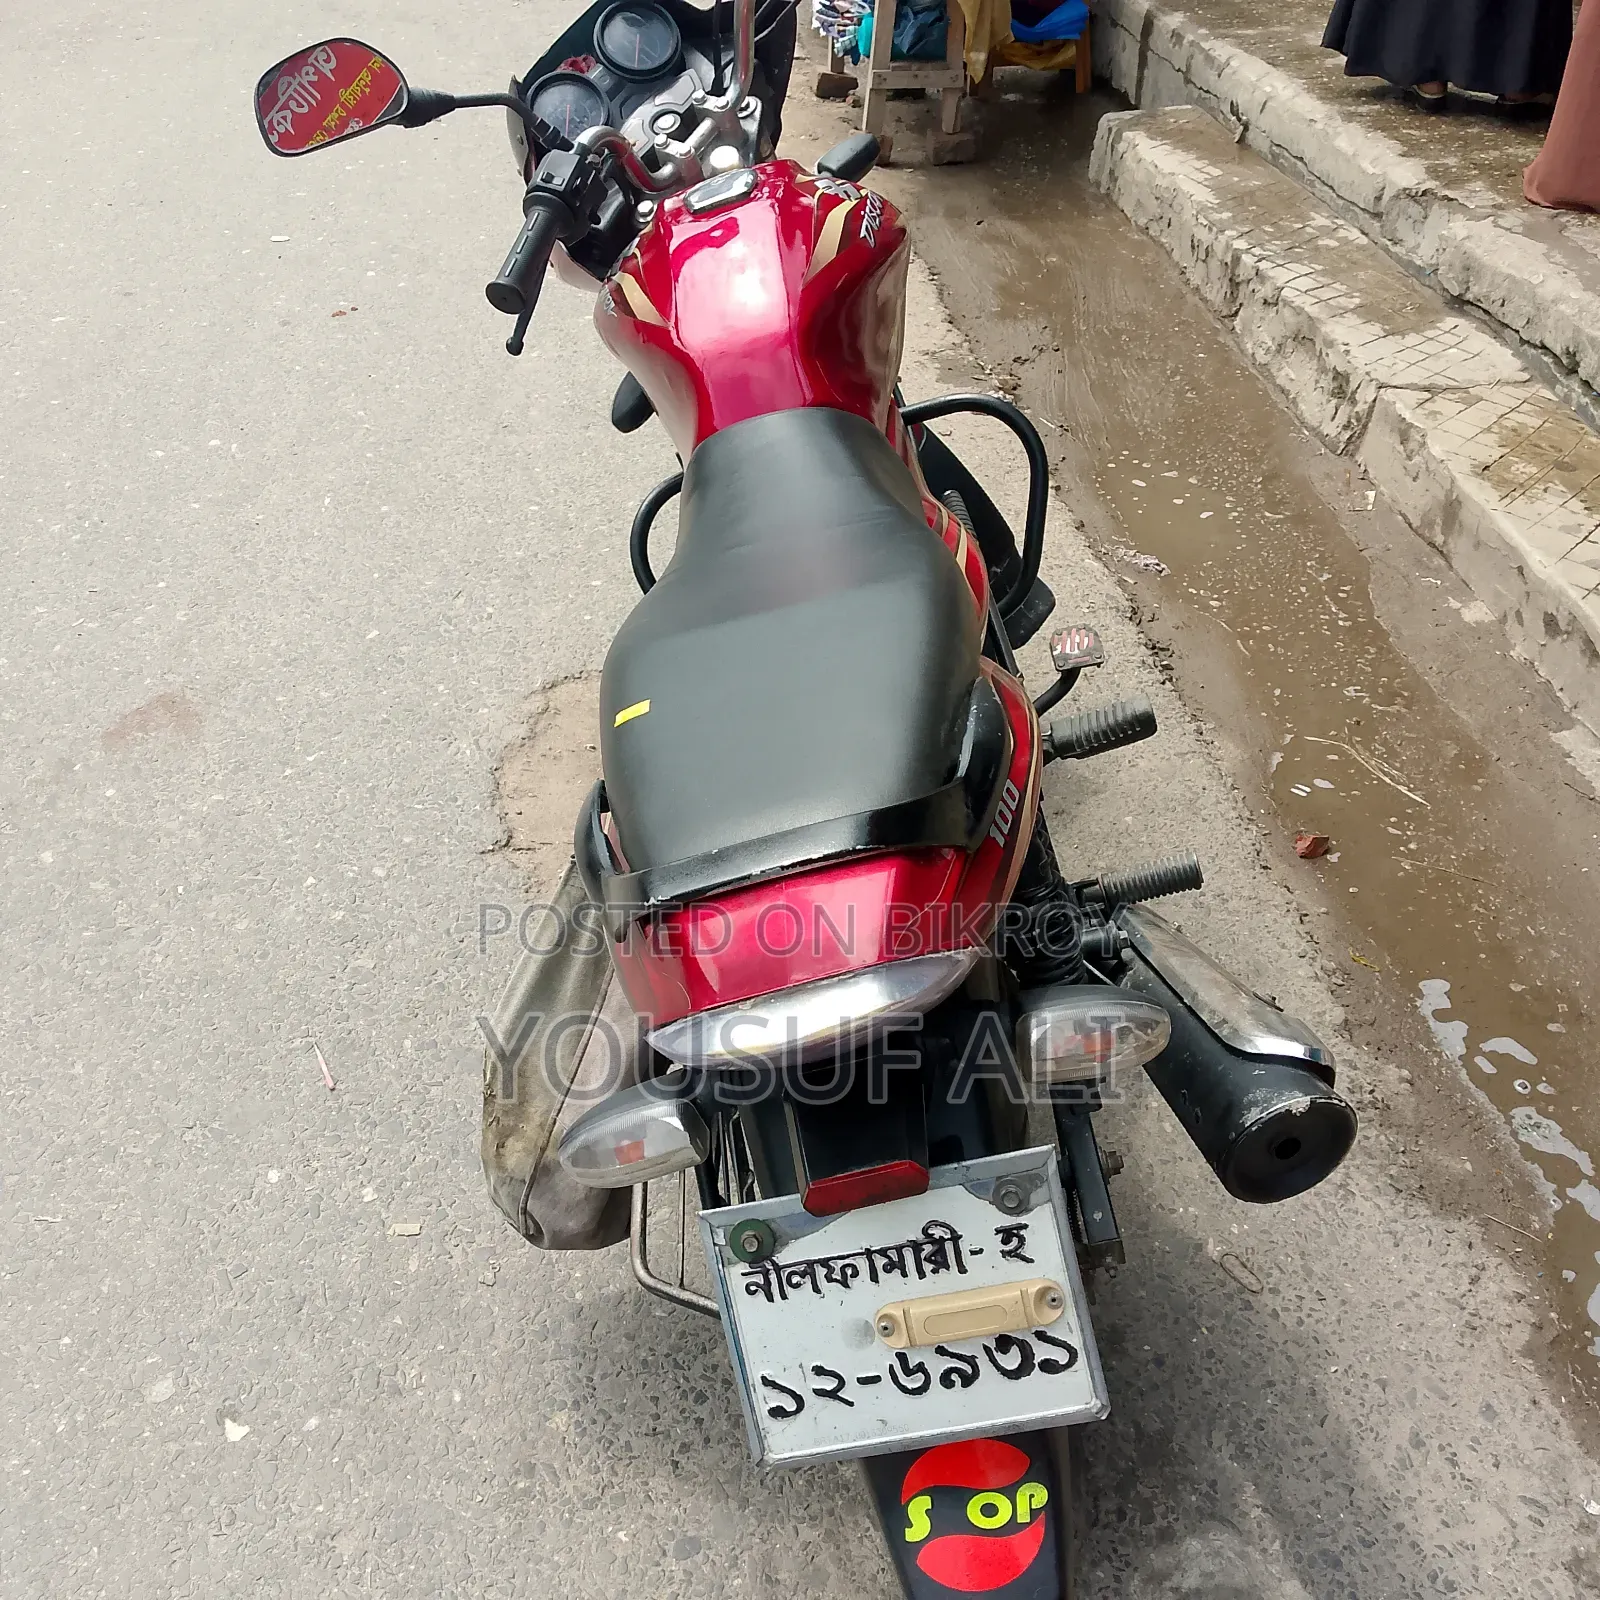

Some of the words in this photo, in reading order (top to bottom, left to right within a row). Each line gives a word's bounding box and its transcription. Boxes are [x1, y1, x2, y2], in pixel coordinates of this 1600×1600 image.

[990, 779, 1020, 848] 100
[760, 1330, 1078, 1419] ১২-৬৯৩১
[905, 1482, 1048, 1542] SOP
